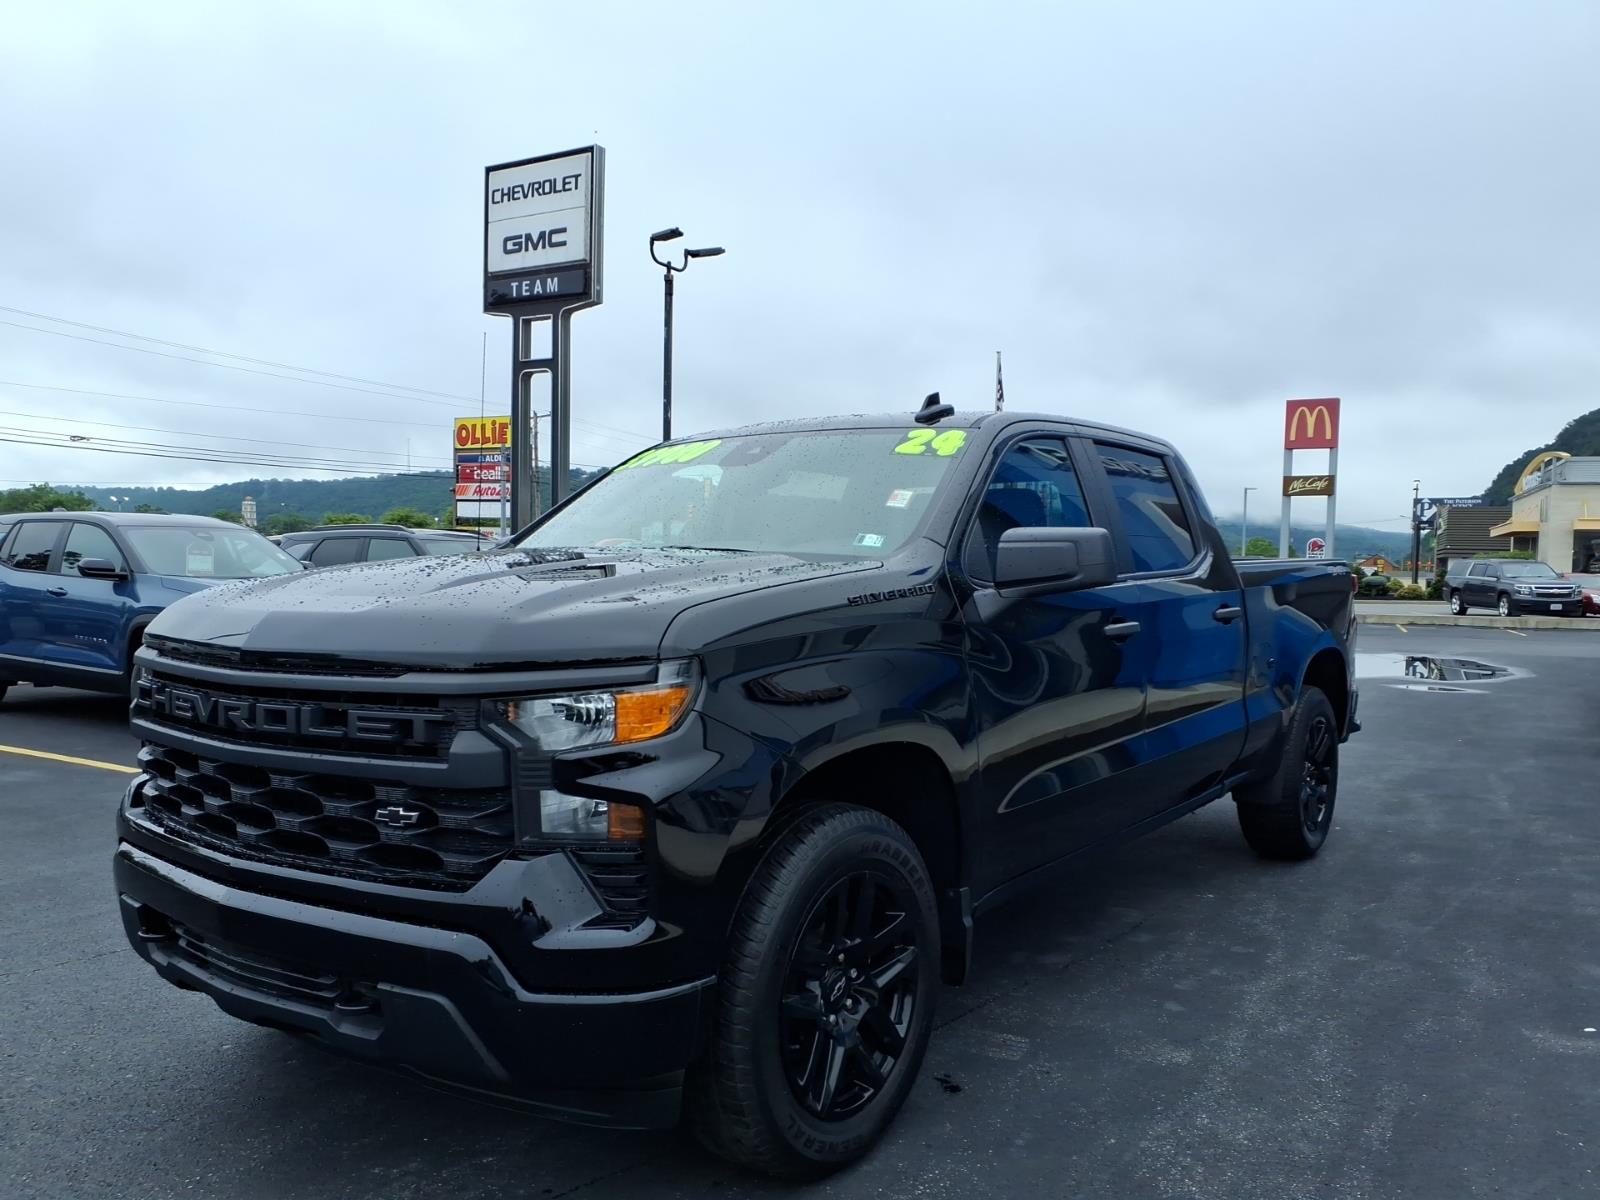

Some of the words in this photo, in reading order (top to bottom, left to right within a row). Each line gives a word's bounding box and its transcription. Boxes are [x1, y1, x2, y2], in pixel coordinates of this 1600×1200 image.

[491, 173, 582, 205] CHEVROLET
[502, 227, 568, 255] GMC
[510, 277, 558, 298] TEAM
[894, 428, 968, 456] 24
[473, 466, 502, 480] beall
[847, 583, 936, 607] SILVERADO
[135, 679, 456, 743] CHEVROLET
